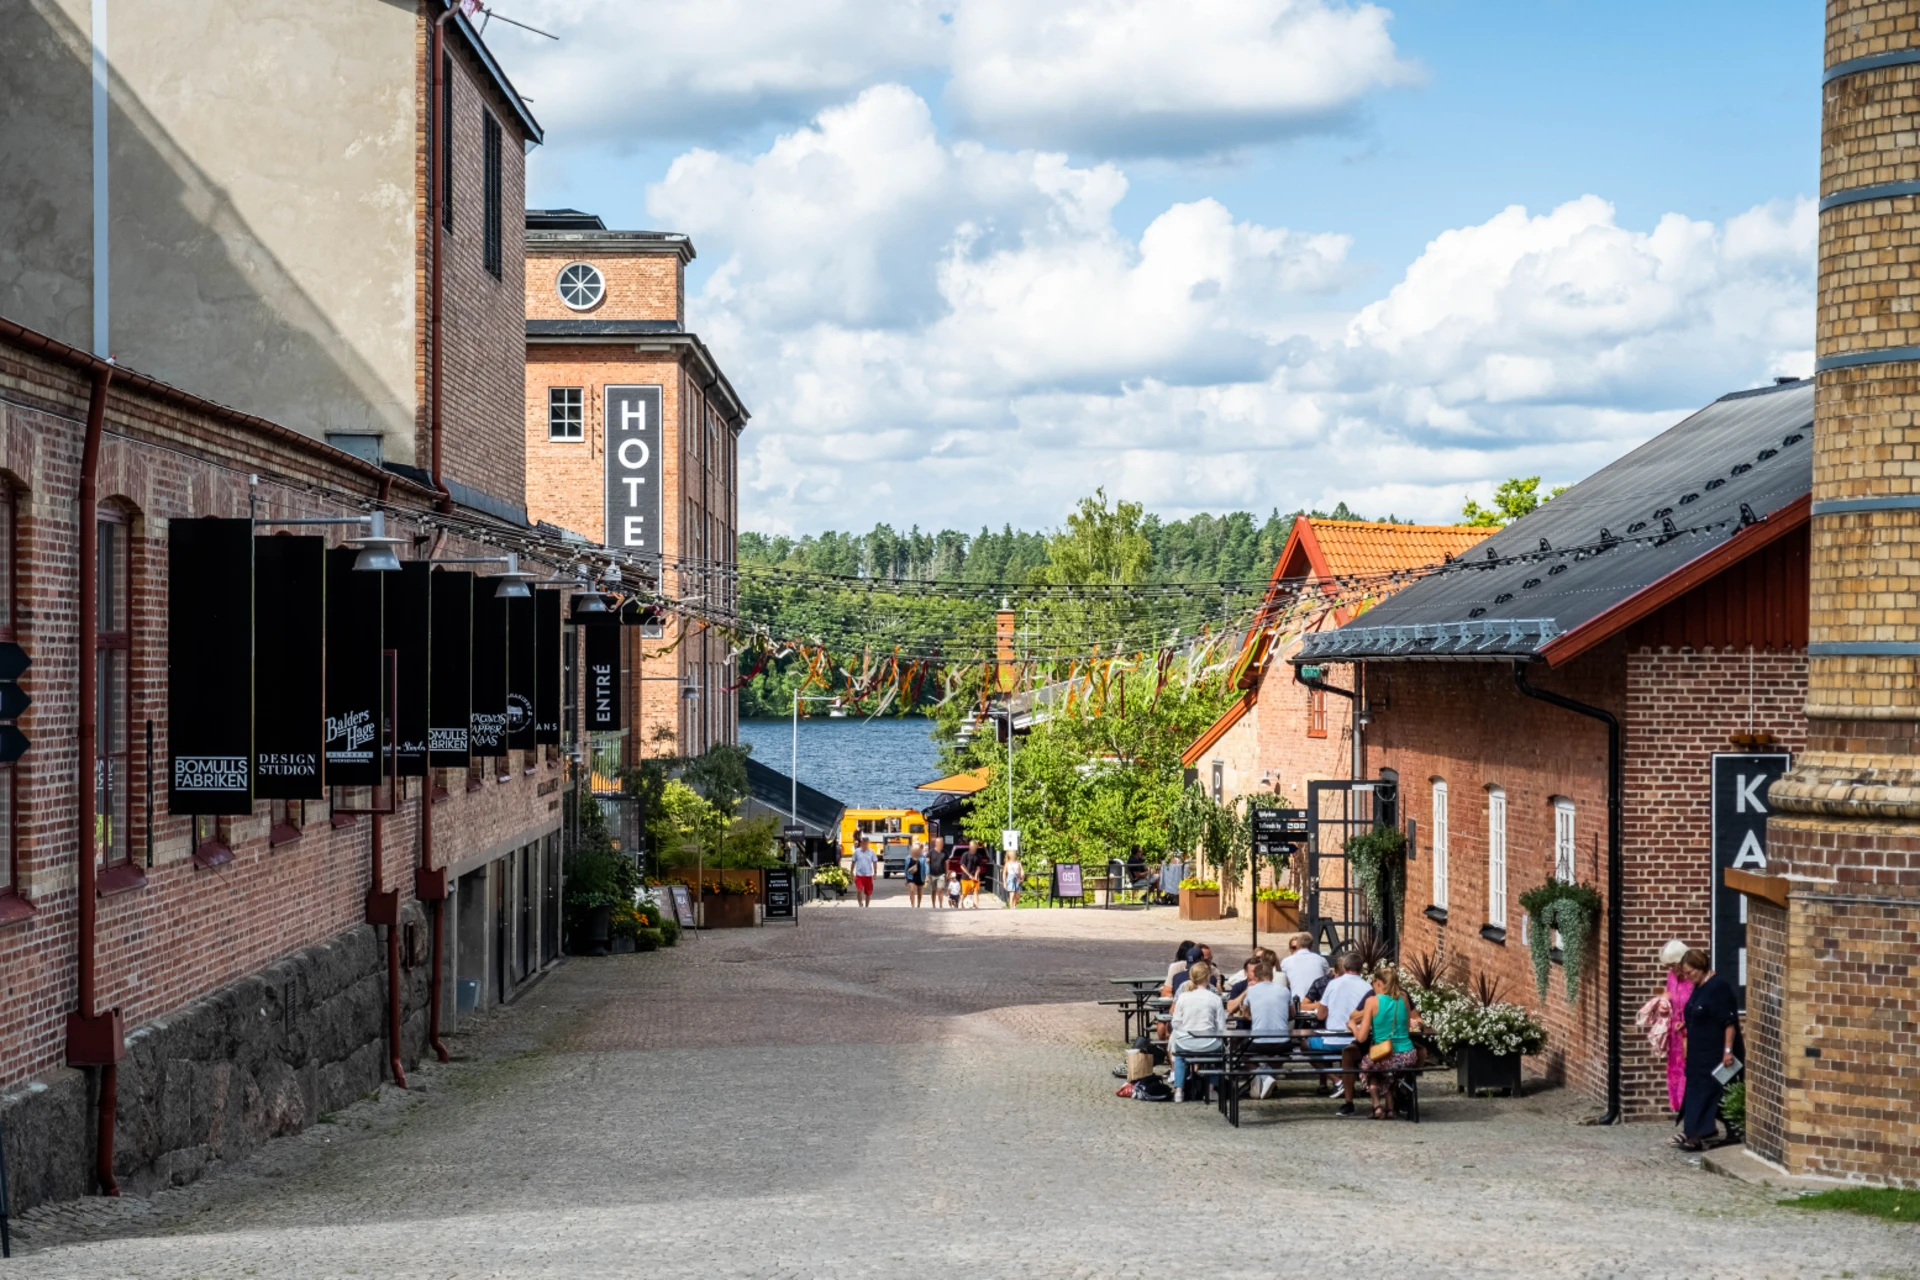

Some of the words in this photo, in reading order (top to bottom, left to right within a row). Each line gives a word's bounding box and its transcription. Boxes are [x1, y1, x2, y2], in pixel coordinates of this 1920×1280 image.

[592, 664, 611, 722] ENTRÉ
[324, 710, 370, 743] Balders
[346, 722, 375, 752] Hage
[428, 740, 468, 749] BRIKEN
[259, 753, 316, 764] DESIGN
[175, 759, 248, 774] BOMULLS
[259, 765, 316, 776] STUDION
[175, 774, 248, 788] FABRIKEN
